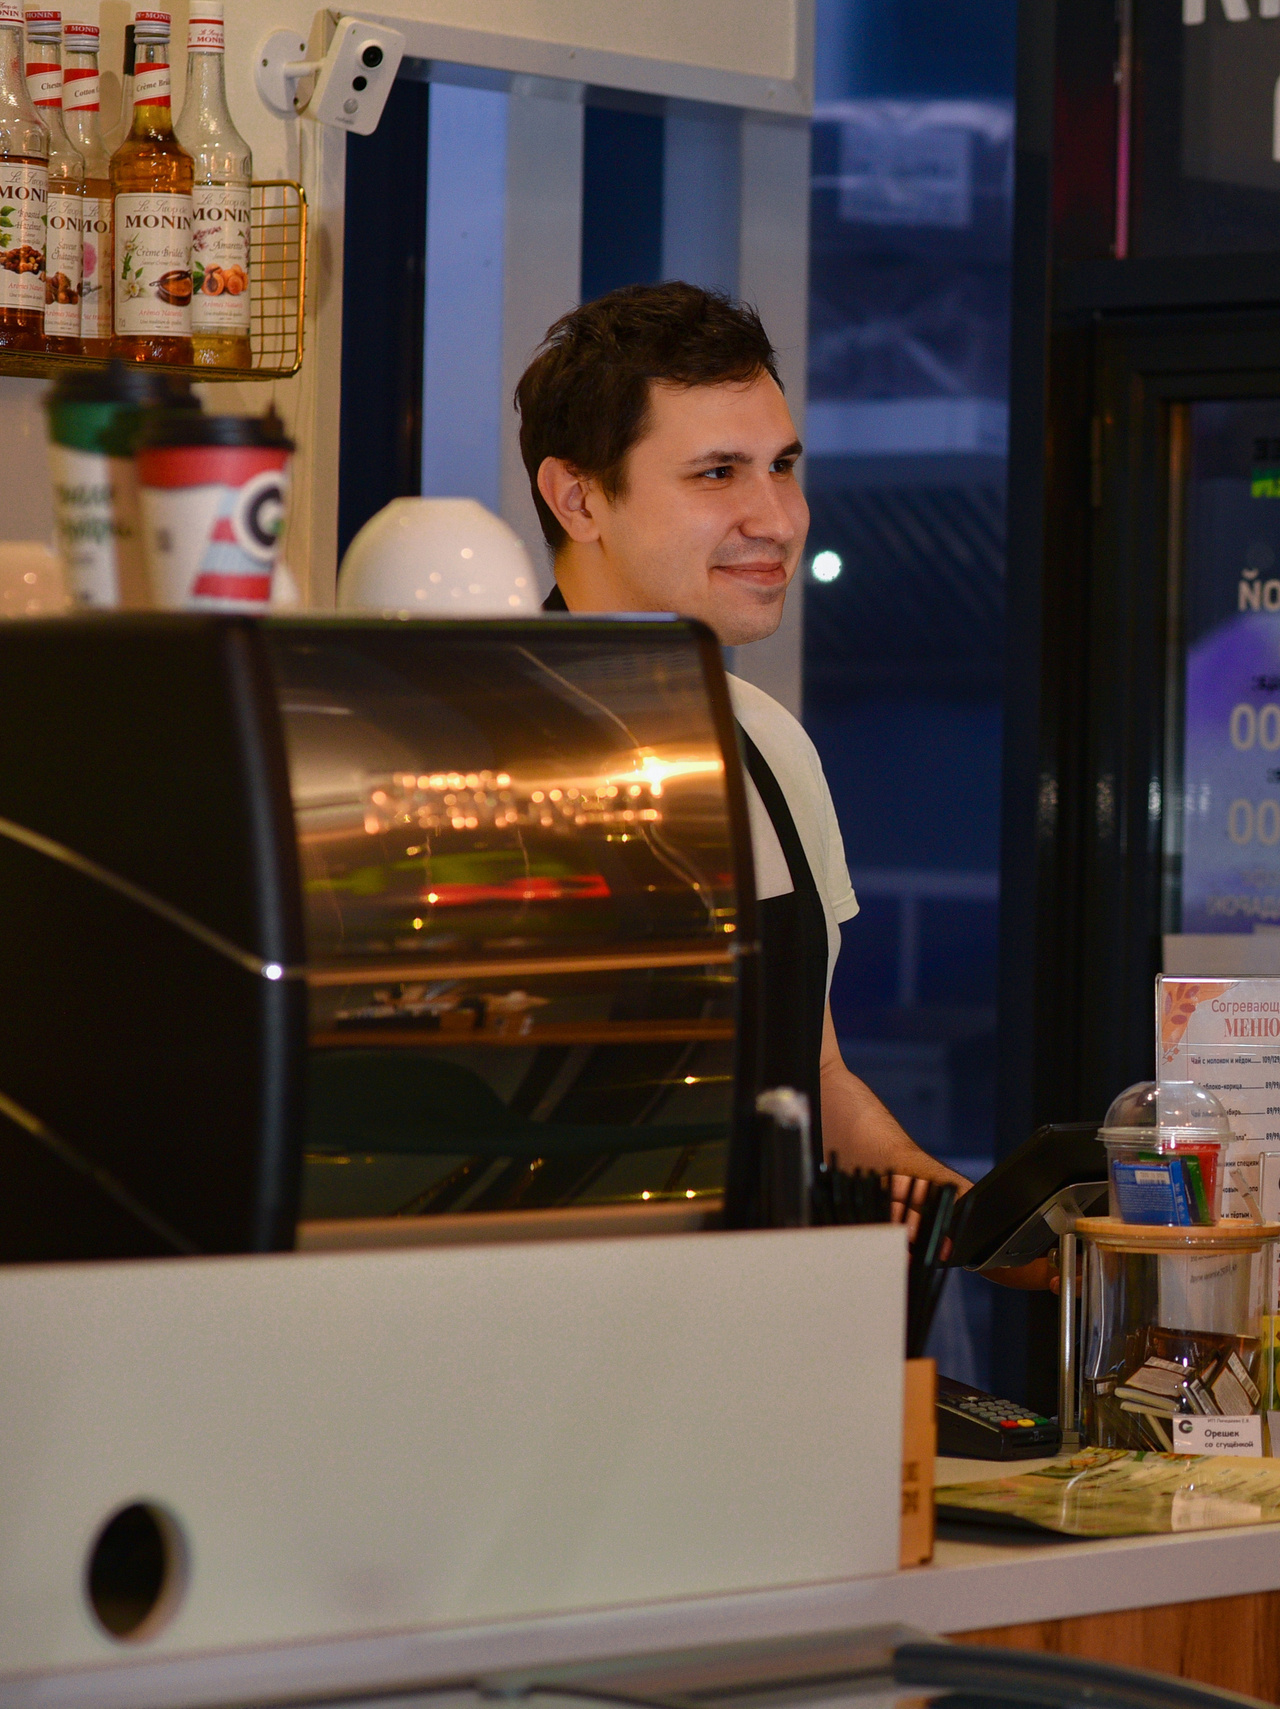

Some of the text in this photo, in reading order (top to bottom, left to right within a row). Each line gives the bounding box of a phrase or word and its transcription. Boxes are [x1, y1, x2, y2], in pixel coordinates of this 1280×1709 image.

[136, 81, 157, 92] Crème
[125, 214, 191, 230] MONIN
[136, 245, 160, 258] Crème
[1224, 1018, 1280, 1038] МЕНЮ
[1191, 1056, 1201, 1064] Чай
[1204, 1429, 1239, 1440] Орешек
[1216, 1441, 1254, 1449] сгущёнкой
